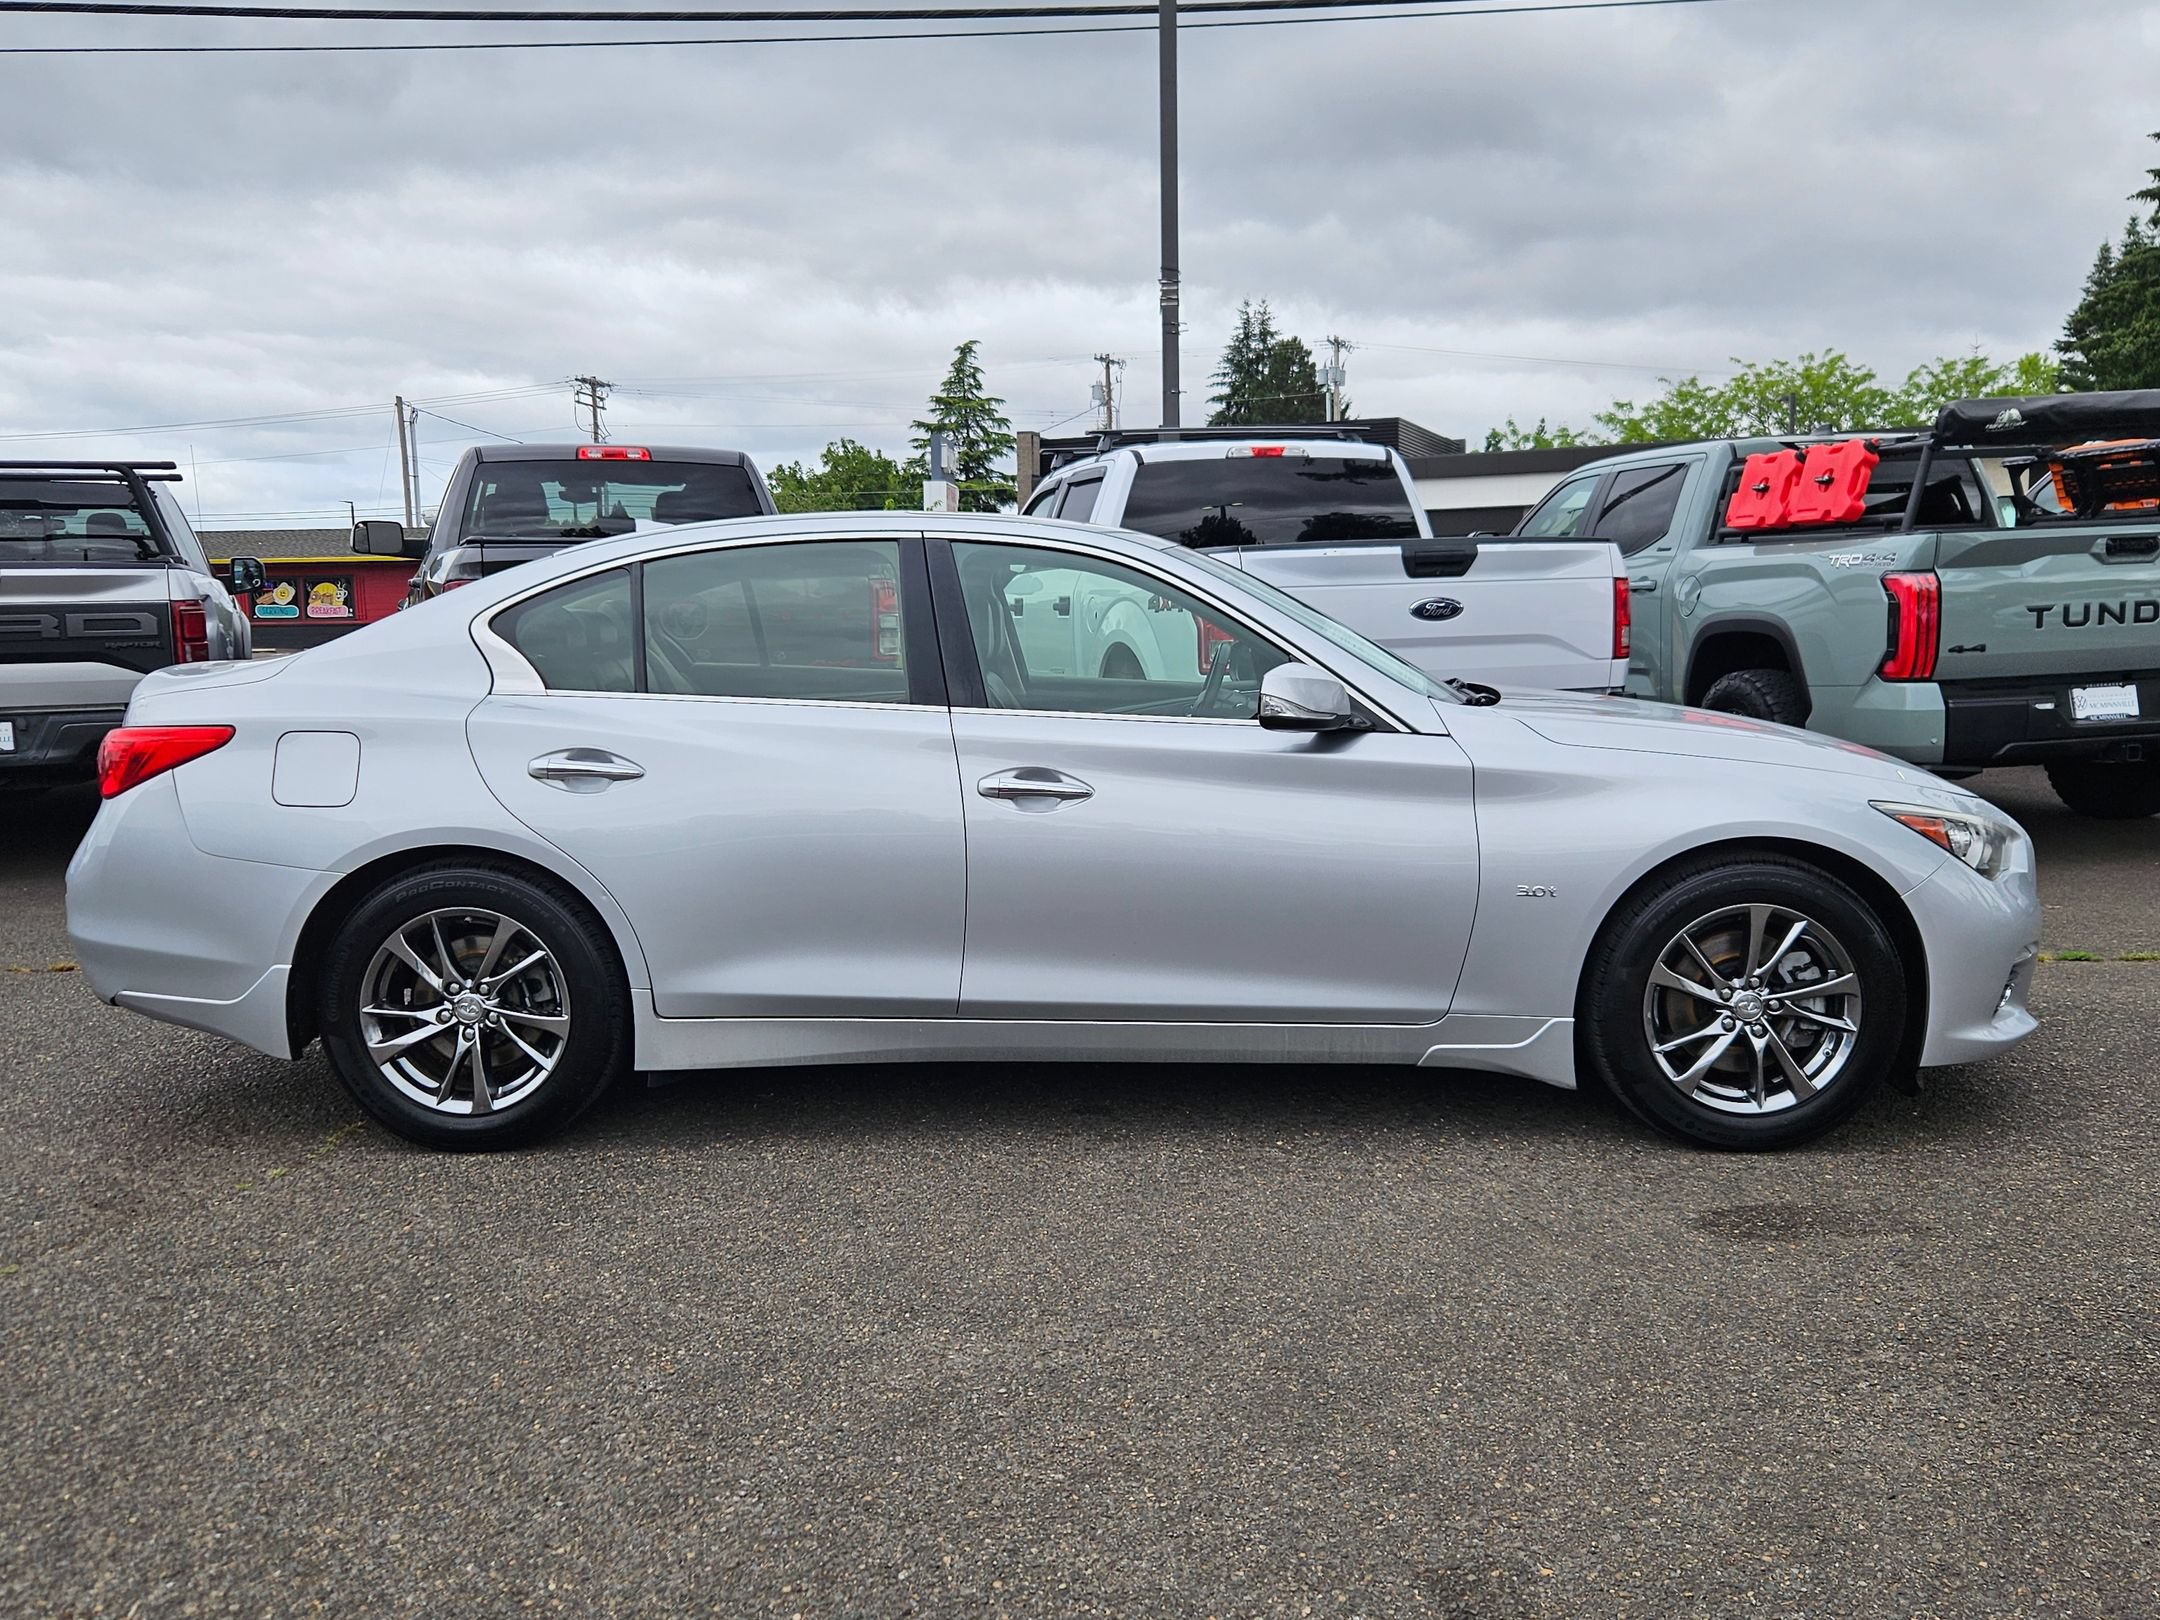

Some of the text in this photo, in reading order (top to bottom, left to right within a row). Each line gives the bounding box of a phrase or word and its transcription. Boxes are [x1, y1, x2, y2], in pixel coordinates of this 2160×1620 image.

[1829, 553, 1863, 568] TRD
[1423, 602, 1453, 616] Ford
[2026, 600, 2160, 629] TUND
[104, 640, 161, 649] RAPTOR
